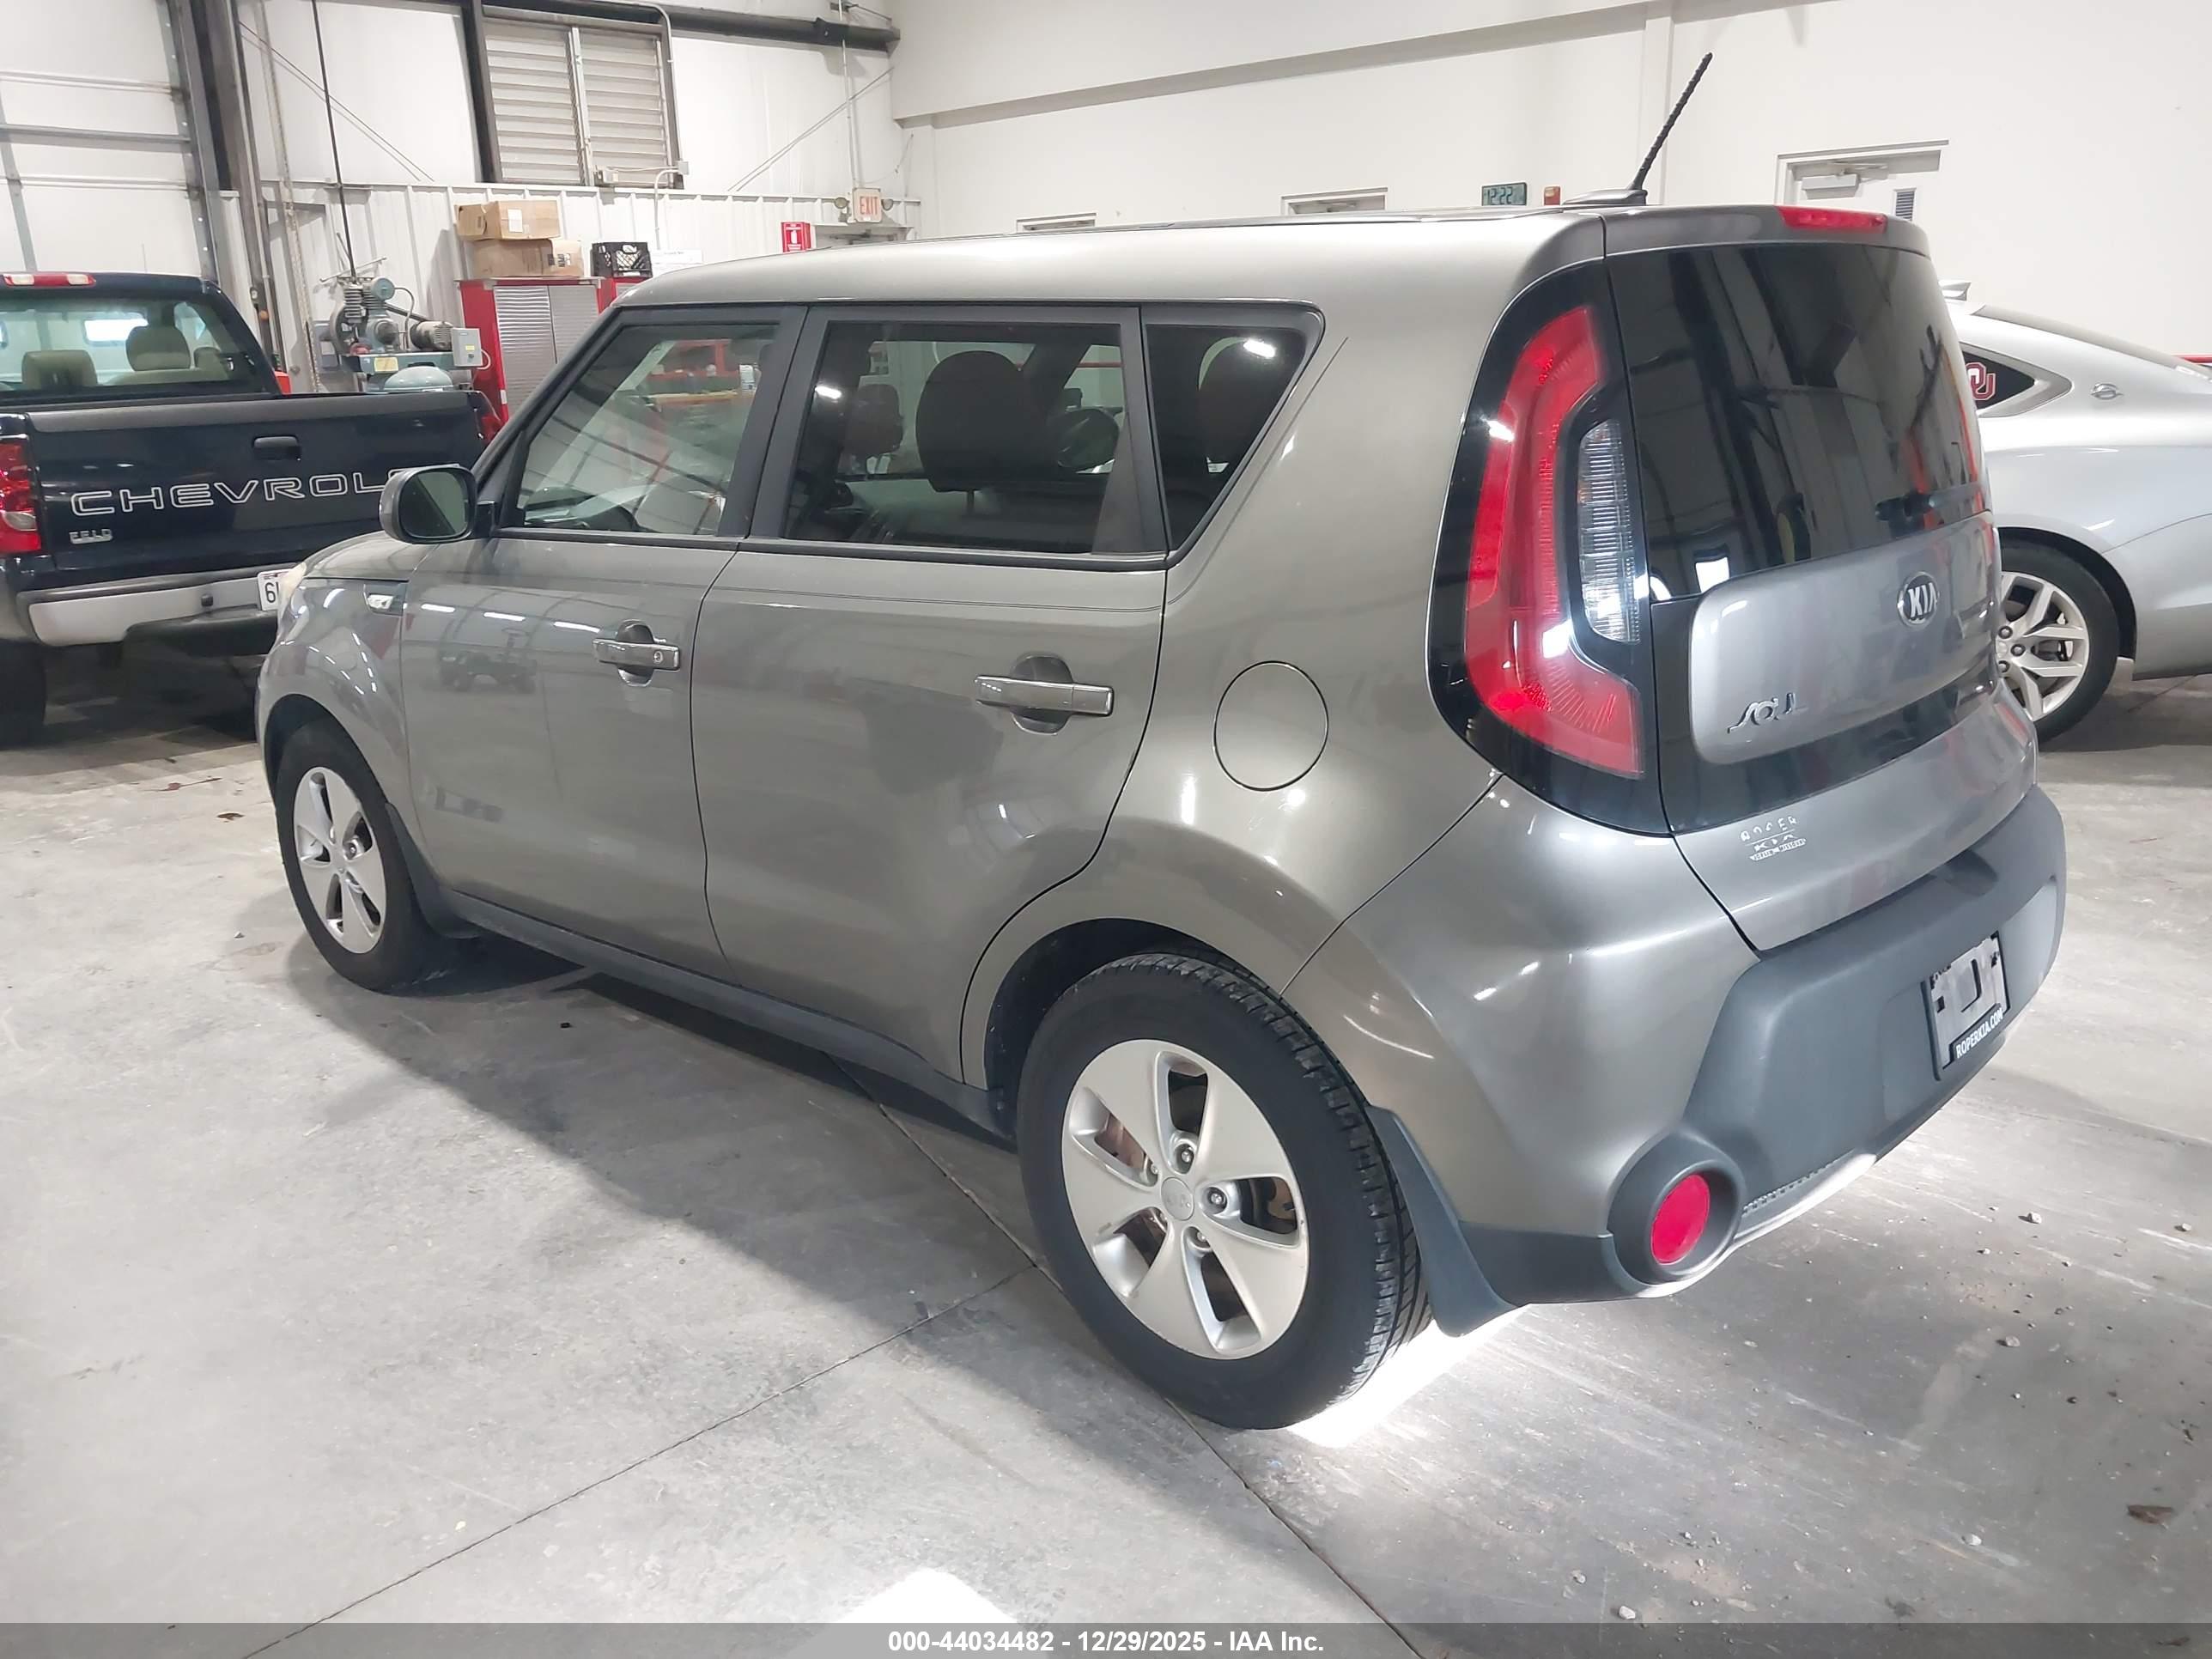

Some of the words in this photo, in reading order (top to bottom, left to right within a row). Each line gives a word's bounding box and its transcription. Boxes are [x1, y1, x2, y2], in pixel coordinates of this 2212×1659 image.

[860, 196, 878, 215] EXIT
[71, 464, 459, 516] CHEVROL
[1907, 581, 1937, 618] KIA
[1727, 692, 1808, 734] SOUL
[1955, 1007, 2003, 1059] ROPERKIA.COM
